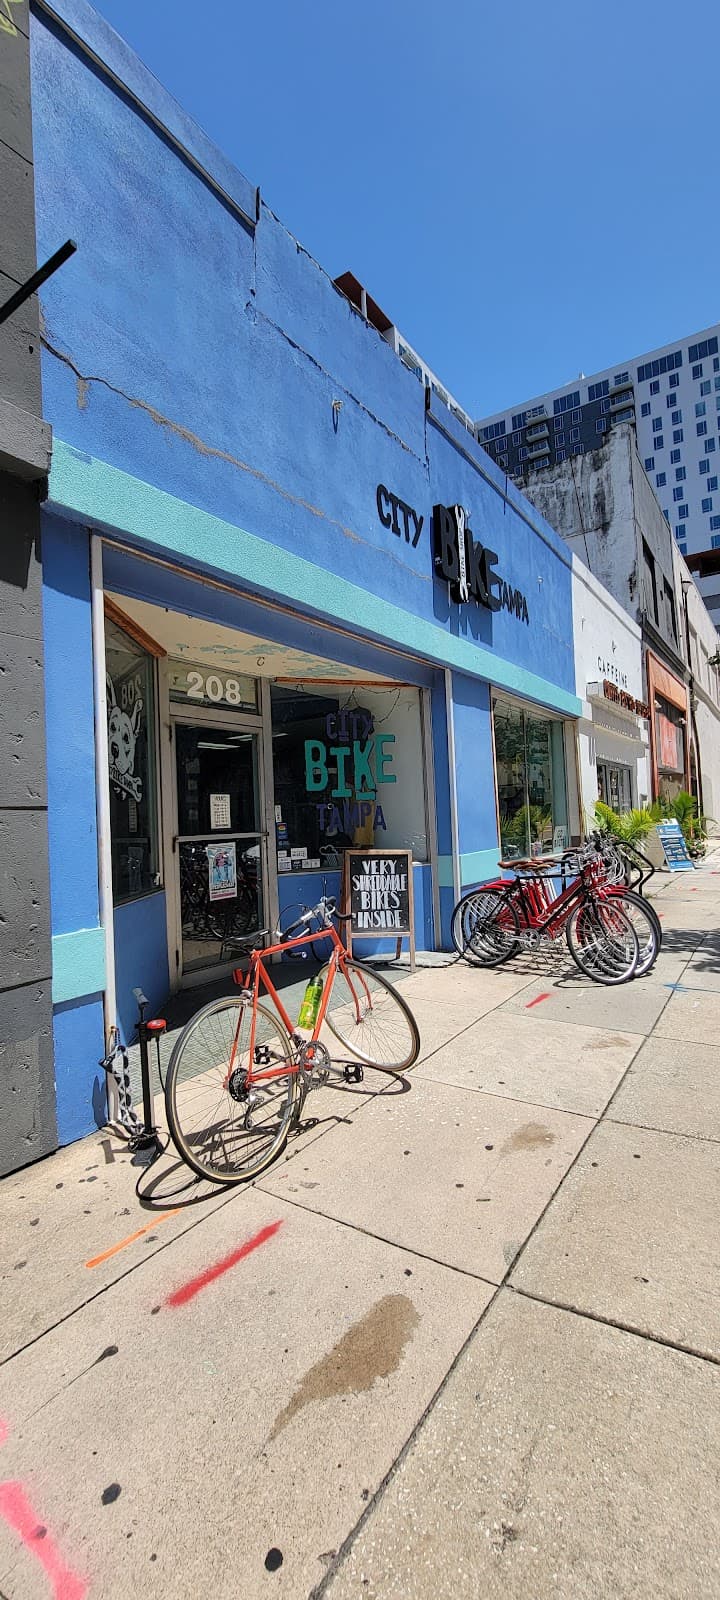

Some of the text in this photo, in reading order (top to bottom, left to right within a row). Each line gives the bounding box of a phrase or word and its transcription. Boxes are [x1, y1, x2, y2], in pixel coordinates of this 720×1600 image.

[376, 483, 529, 627] CITY BIKE TAMPA
[186, 671, 241, 704] 208
[597, 656, 628, 688] CAFFEINE
[325, 710, 373, 741] CITY
[304, 734, 397, 800] BIKE
[316, 801, 387, 833] TAMPA
[361, 859, 397, 874] VERY
[361, 890, 400, 909] BIKES
[357, 909, 405, 928] INSIDE
